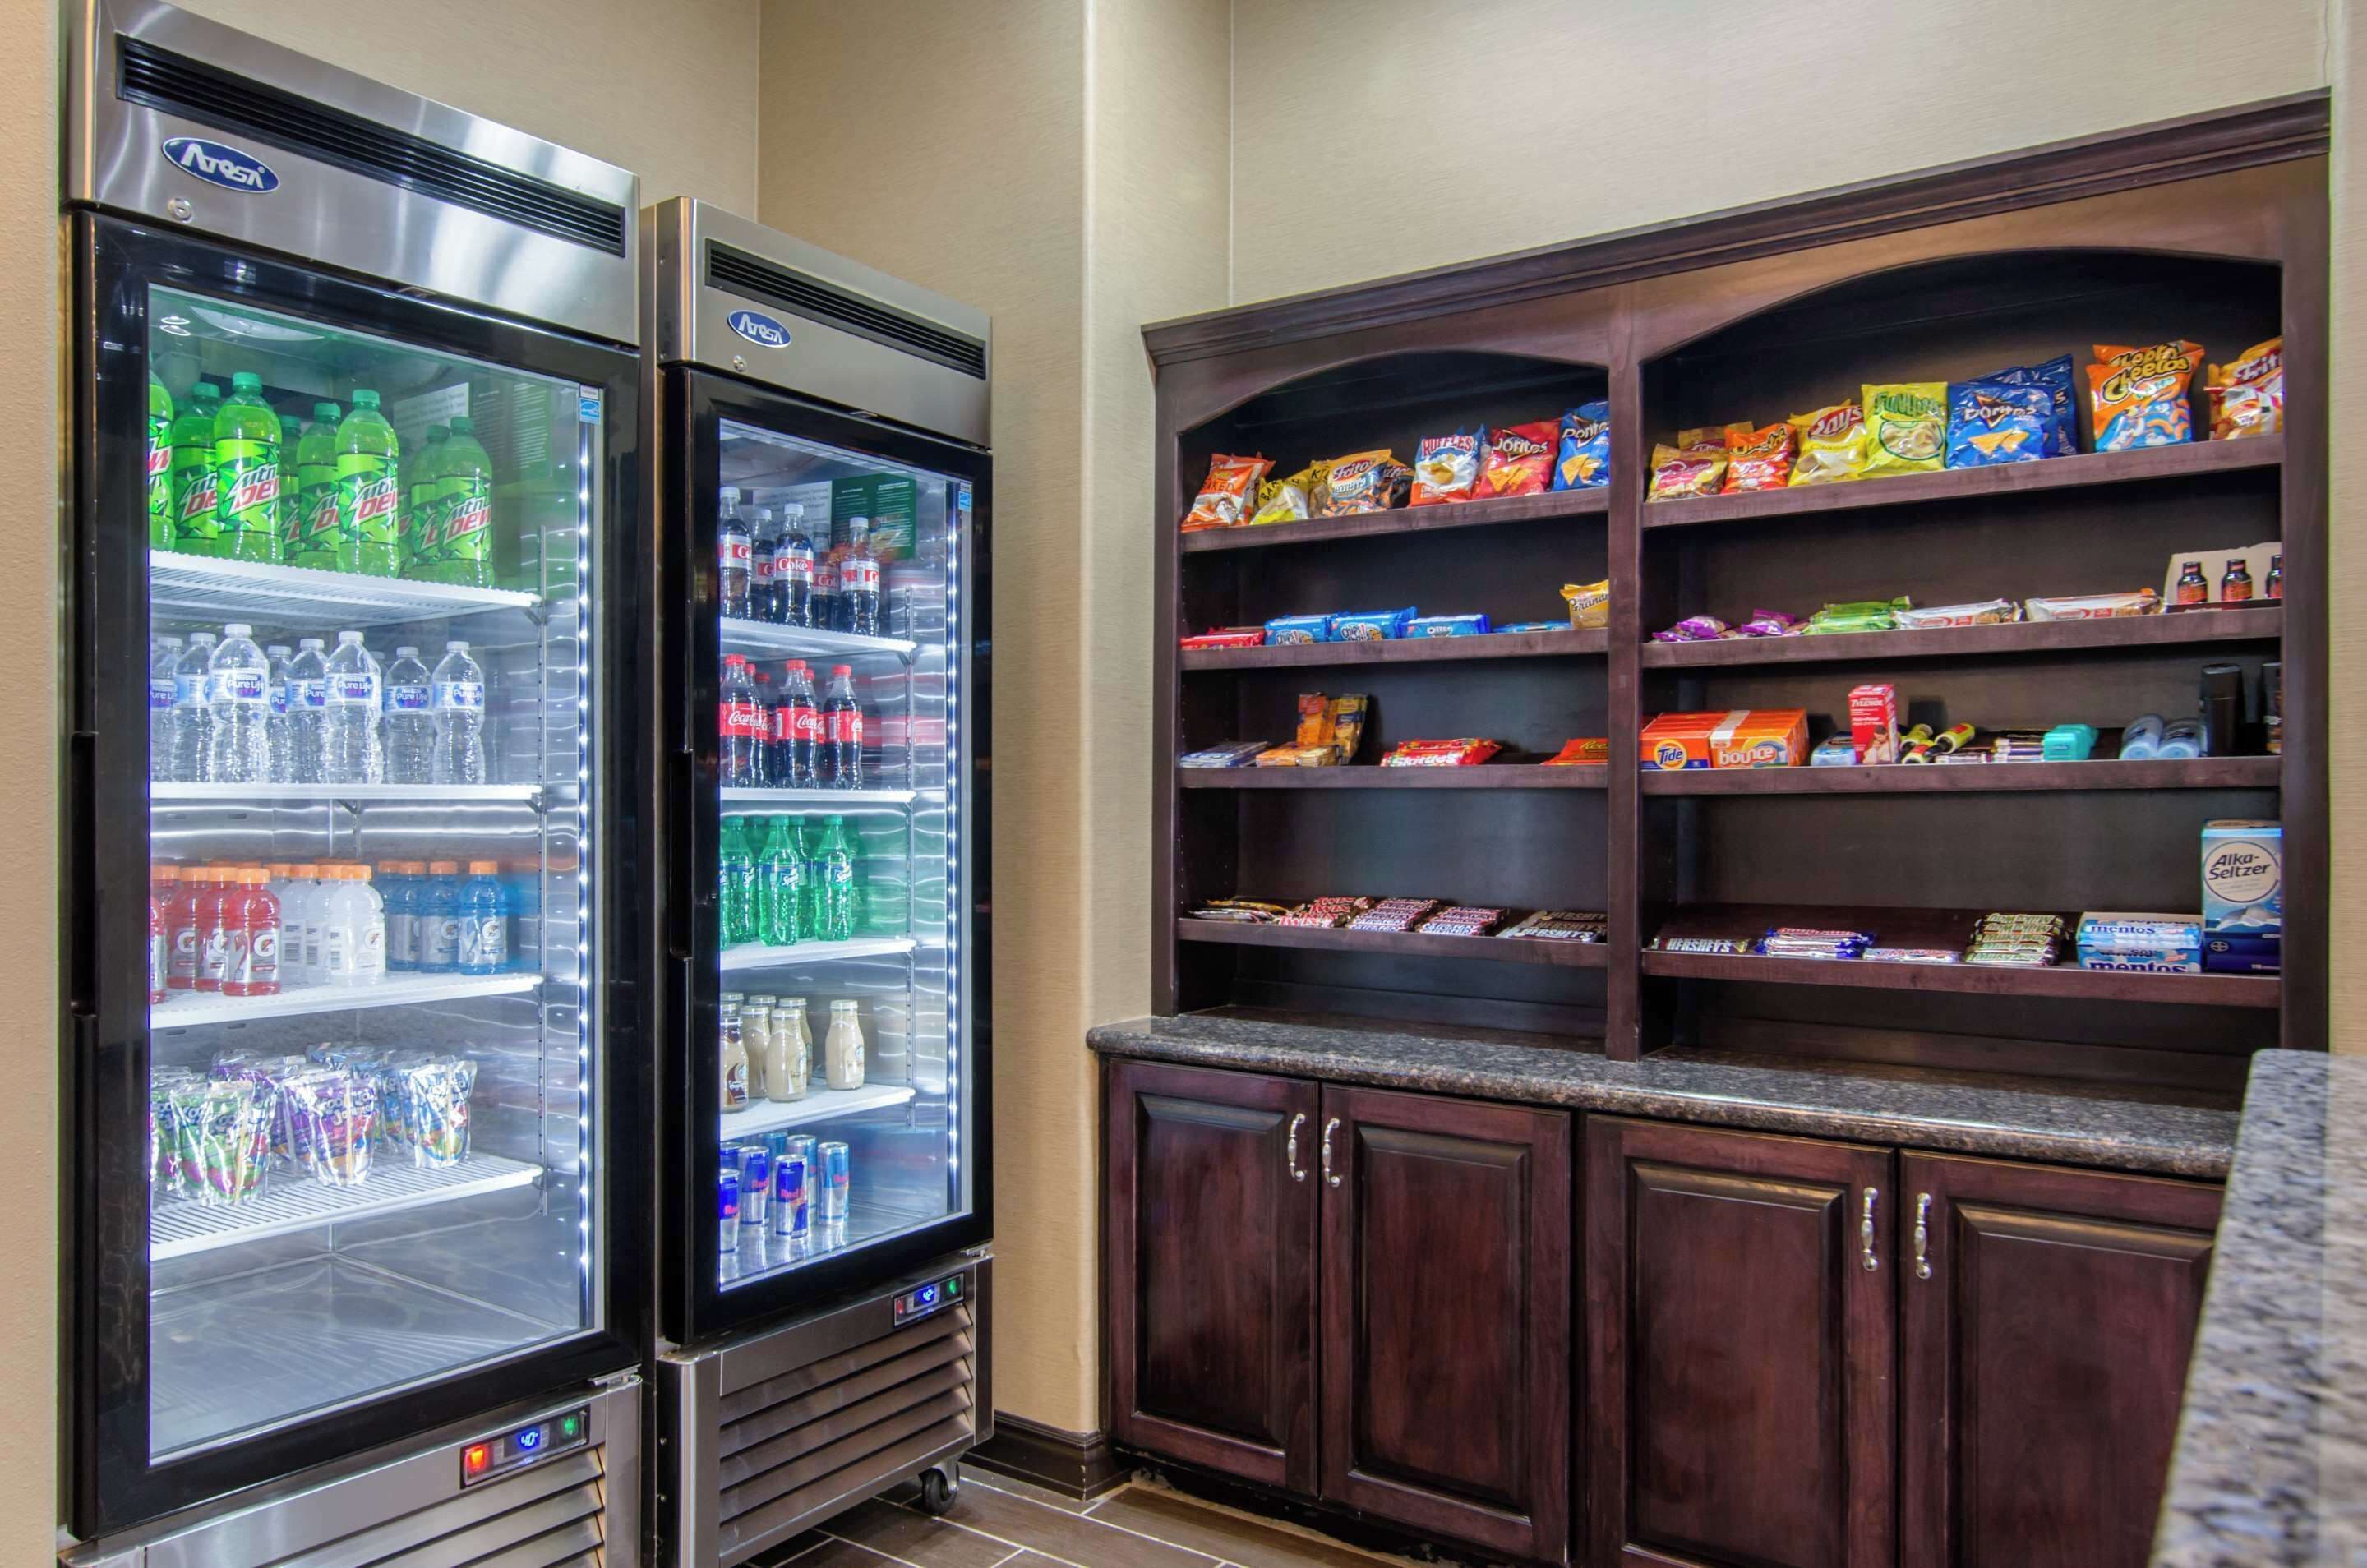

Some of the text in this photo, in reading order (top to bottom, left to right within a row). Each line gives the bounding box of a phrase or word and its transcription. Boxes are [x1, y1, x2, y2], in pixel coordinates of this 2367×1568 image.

[2104, 357, 2189, 401] Cheetos
[1964, 405, 2037, 422] Doritos
[779, 557, 809, 572] Coke
[1658, 746, 1683, 763] Tide
[1719, 746, 1777, 765] bounce
[2212, 853, 2259, 868] Alka-
[2209, 864, 2271, 880] Seltzer
[2091, 925, 2156, 934] mentos
[253, 934, 275, 957] G
